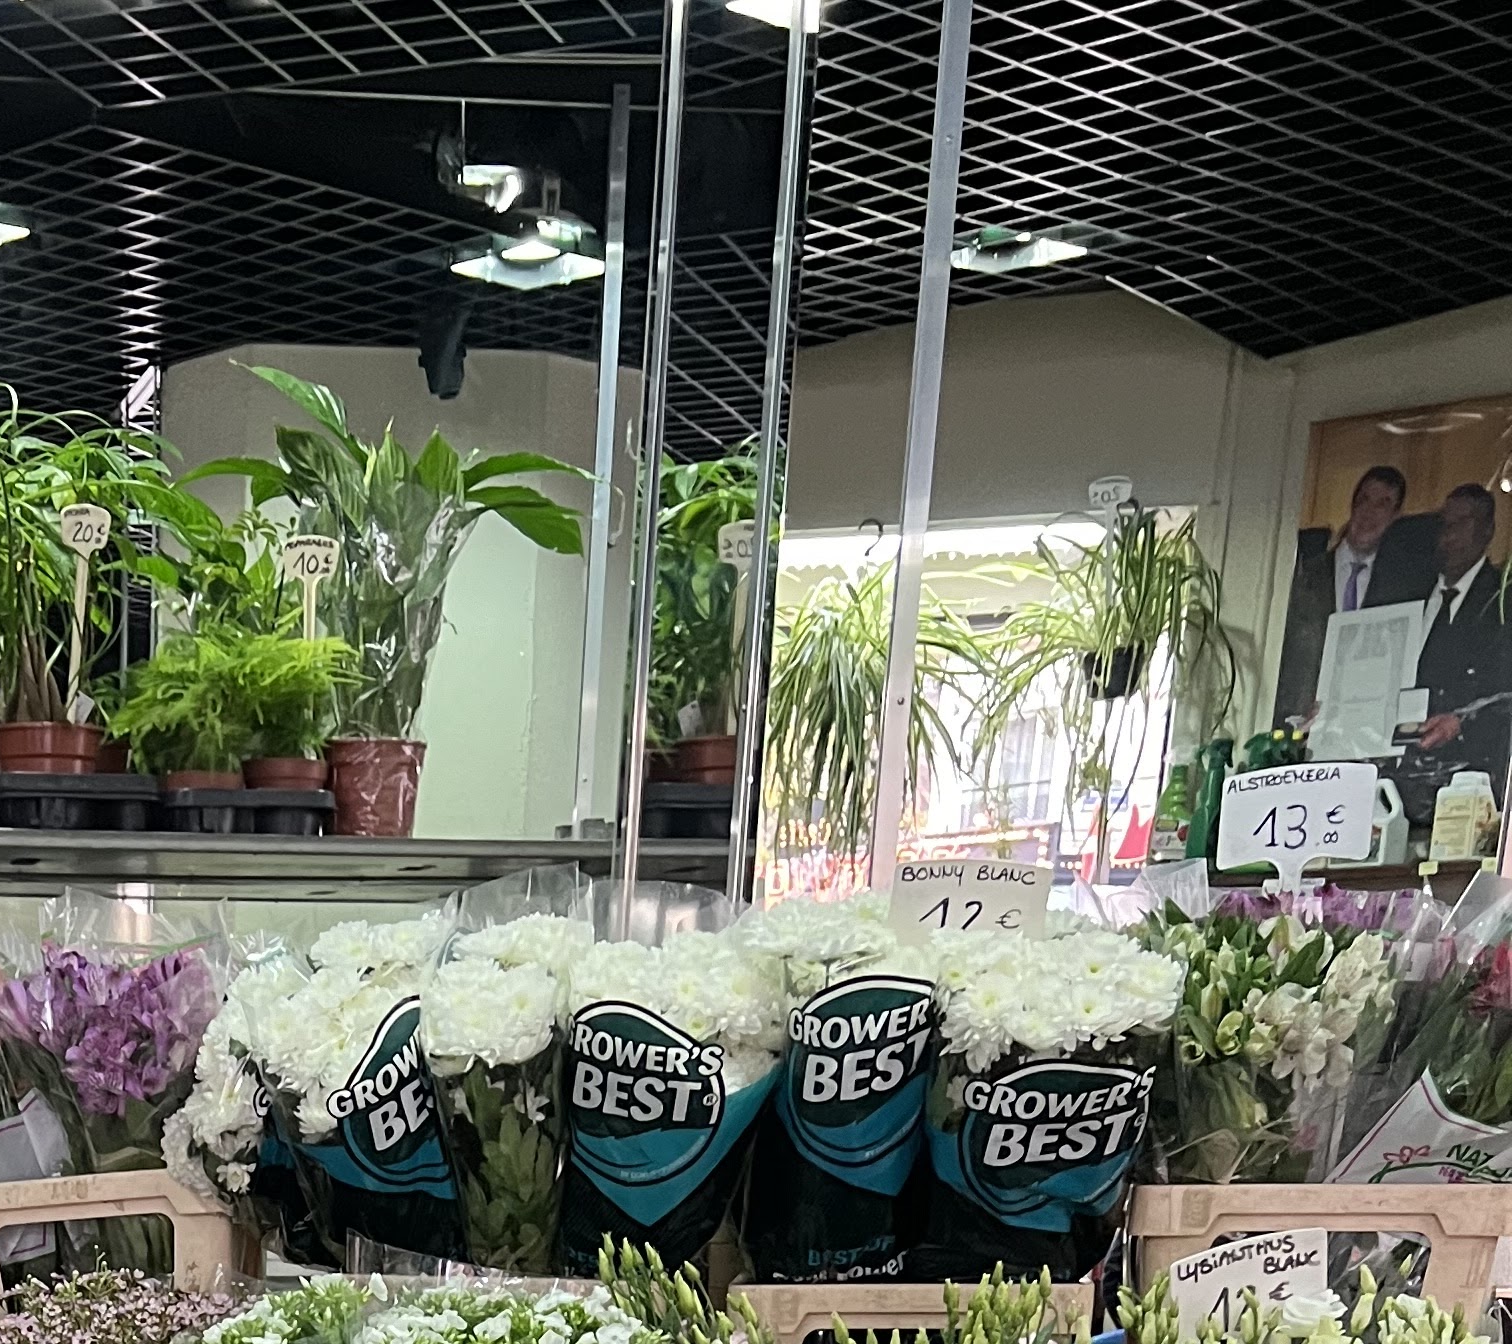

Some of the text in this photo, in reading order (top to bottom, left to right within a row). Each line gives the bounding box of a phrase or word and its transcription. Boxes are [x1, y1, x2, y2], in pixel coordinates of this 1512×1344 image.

[72, 521, 93, 543] 20
[293, 552, 319, 576] 10
[1253, 804, 1307, 849] 13
[1326, 804, 1346, 824] €
[901, 864, 1036, 887] BONNY BLANC
[995, 909, 1022, 929] €
[802, 1027, 931, 1103] BEST
[573, 1061, 702, 1122] BEST
[965, 1065, 1156, 1119] GROWER'S
[983, 1107, 1137, 1167] BEST
